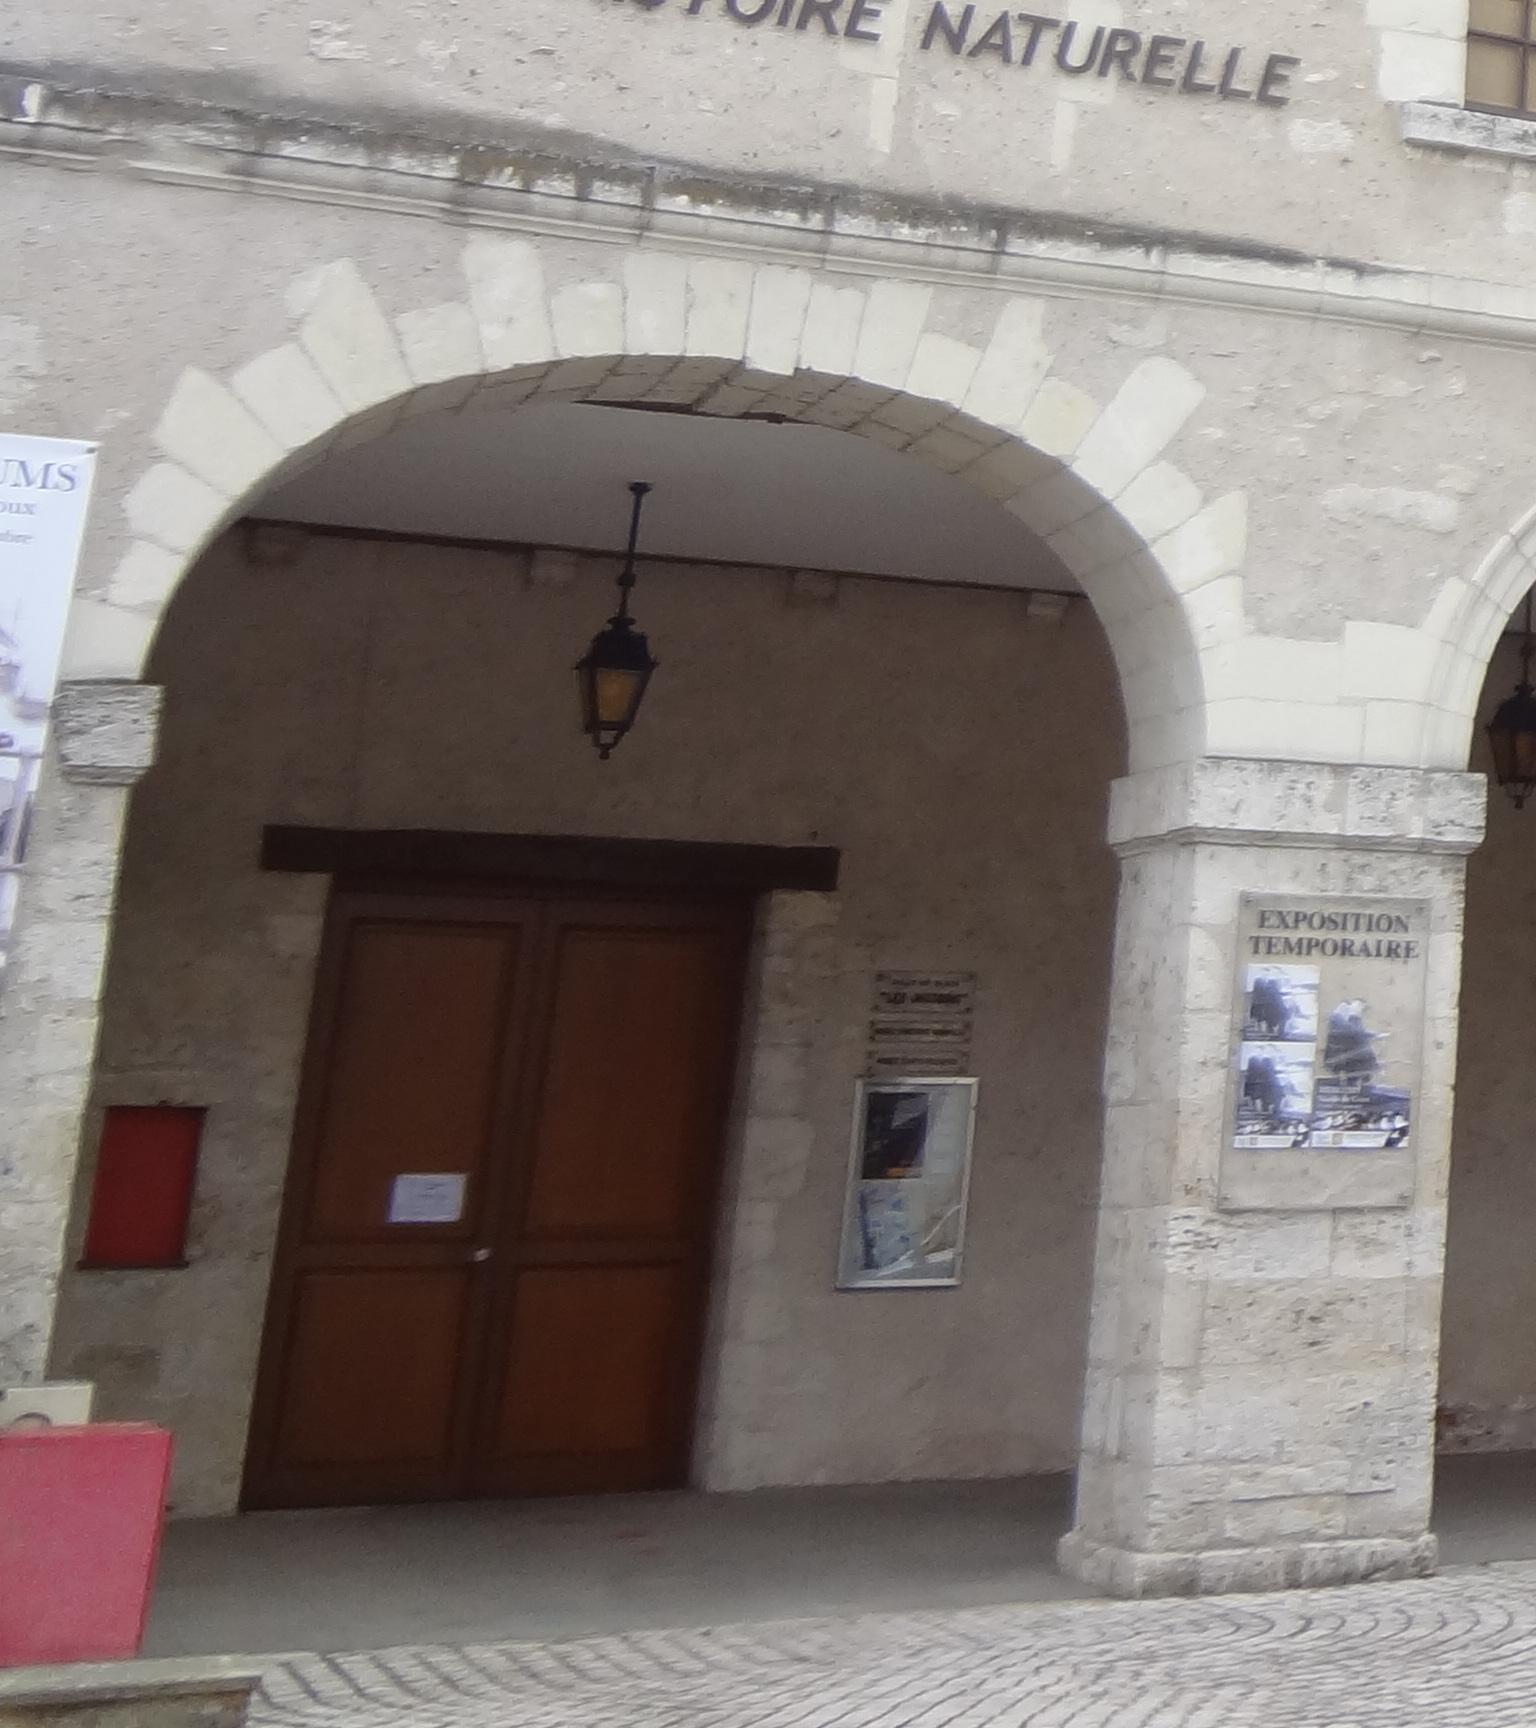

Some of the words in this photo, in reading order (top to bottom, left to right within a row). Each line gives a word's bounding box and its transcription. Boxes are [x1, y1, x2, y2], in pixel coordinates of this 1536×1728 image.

[919, 0, 1302, 107] NATURELLE
[1257, 908, 1412, 934] EXPOSITION
[1249, 935, 1420, 960] TEMPORAIRE
